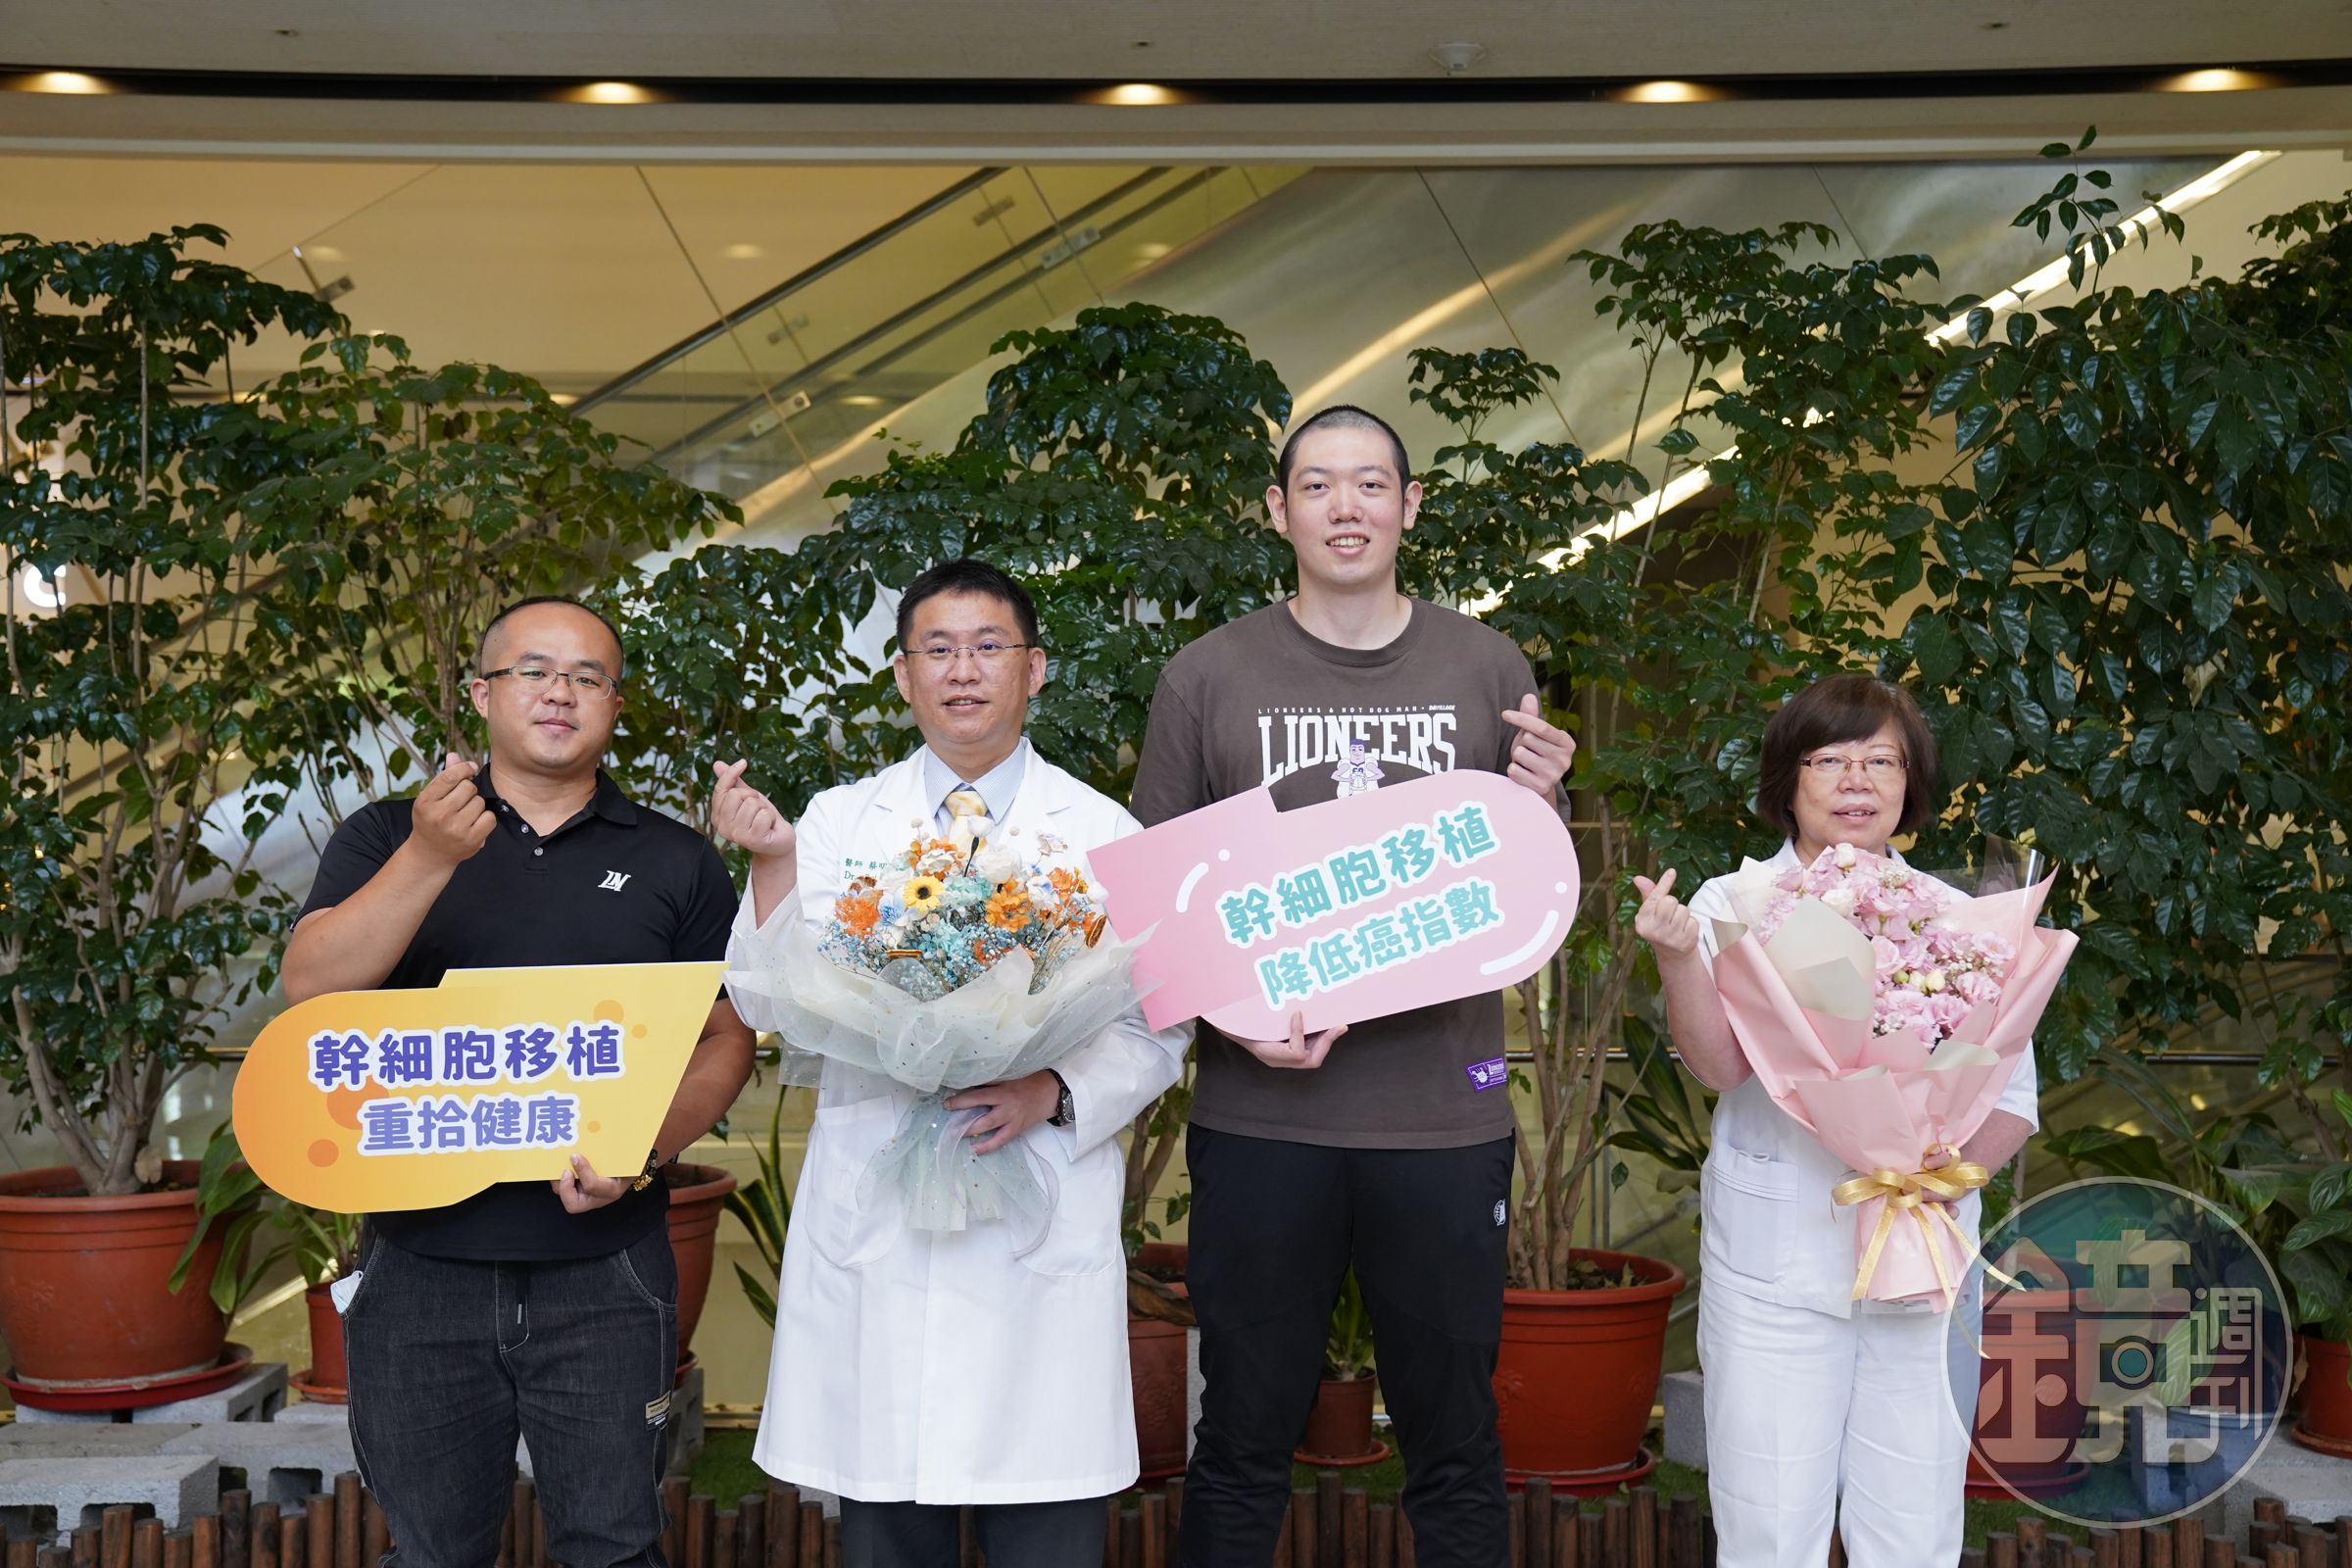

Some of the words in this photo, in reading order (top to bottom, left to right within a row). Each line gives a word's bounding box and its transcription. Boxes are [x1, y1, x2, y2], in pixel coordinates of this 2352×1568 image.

[1257, 712, 1457, 787] LIONEERS
[1220, 806, 1496, 945] 幹細胞移植
[1258, 880, 1500, 1005] 降低癌指數
[313, 1024, 621, 1087] 幹細胞移植
[363, 1095, 576, 1152] 重拾健康
